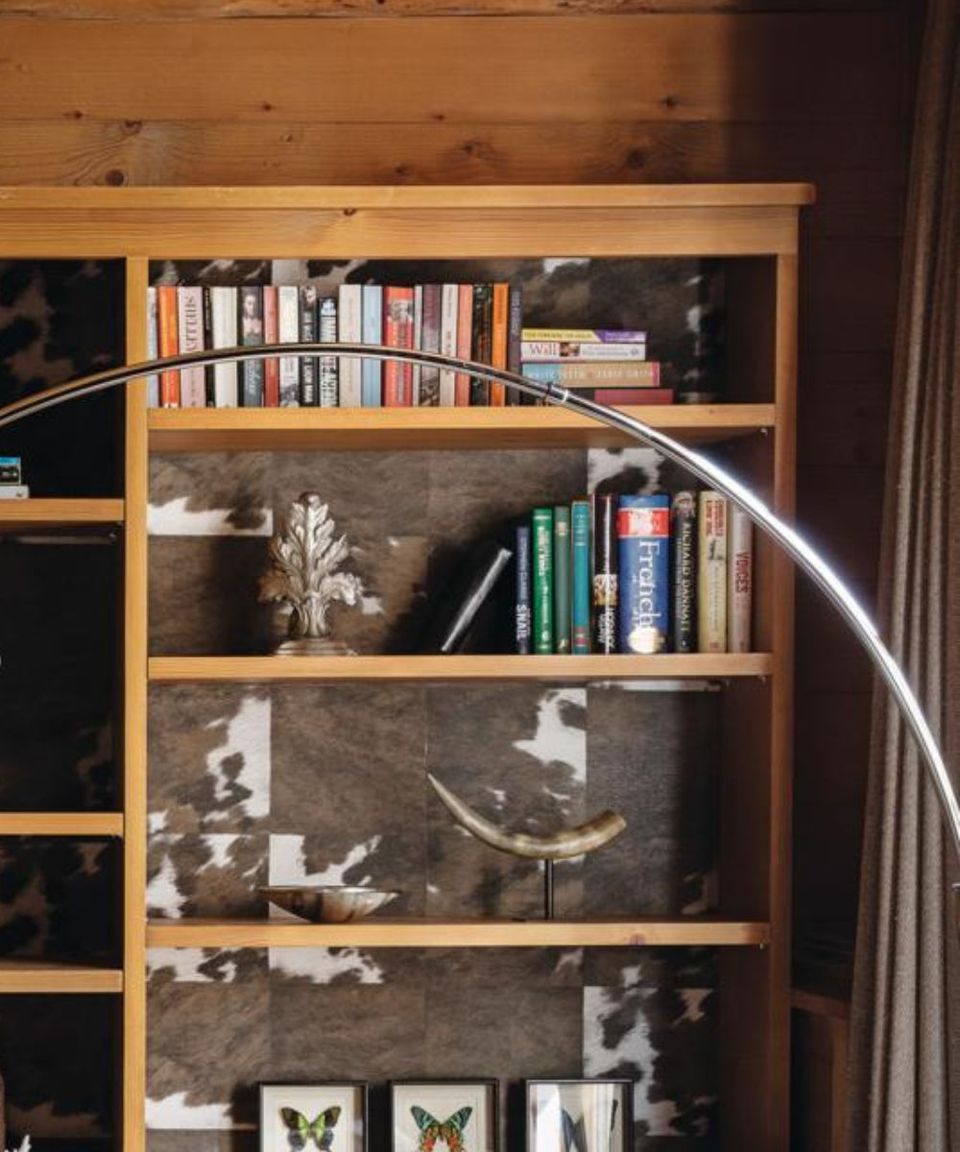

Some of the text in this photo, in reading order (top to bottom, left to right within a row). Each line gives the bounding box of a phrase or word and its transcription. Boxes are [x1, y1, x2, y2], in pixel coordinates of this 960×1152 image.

[681, 522, 692, 576] RICHARD
[638, 540, 662, 627] French
[516, 604, 528, 641] SNAIL
